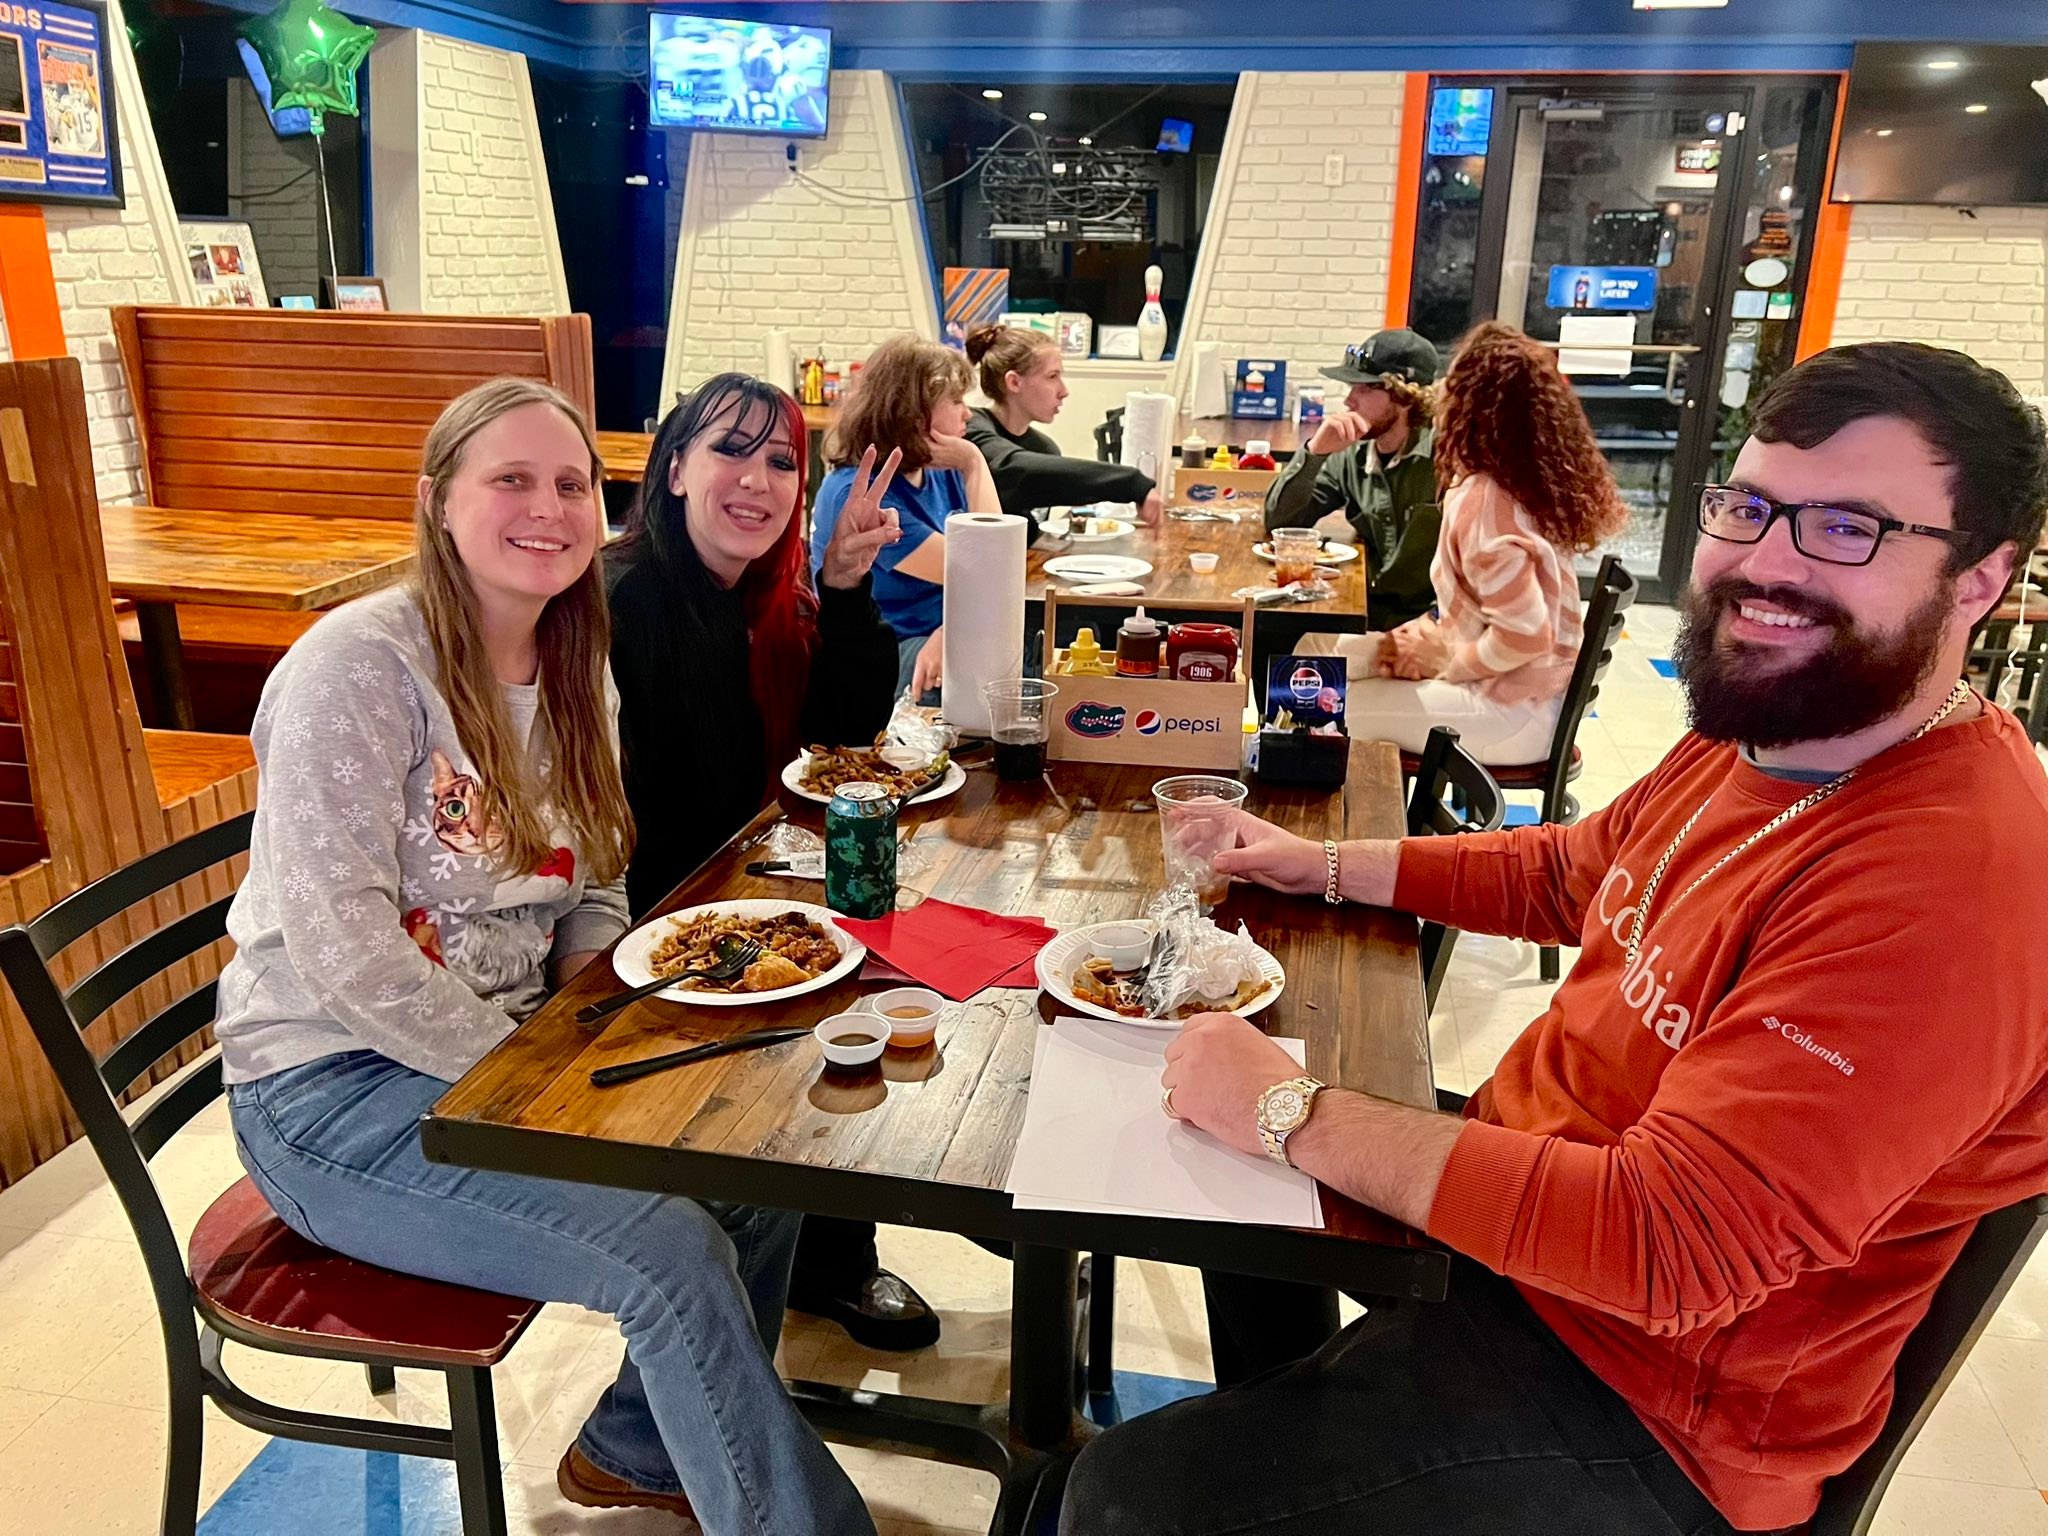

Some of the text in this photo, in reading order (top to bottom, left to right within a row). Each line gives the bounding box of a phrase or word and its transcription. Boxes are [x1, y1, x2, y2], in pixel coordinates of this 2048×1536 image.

[1618, 279, 1639, 290] YOU
[1600, 289, 1630, 299] LATER
[1190, 665, 1213, 678] 1906
[1292, 679, 1321, 687] PEPSI
[1165, 717, 1221, 734] pepsi
[1599, 867, 1691, 1051] Cobia
[1781, 1023, 1855, 1077] Columbia
